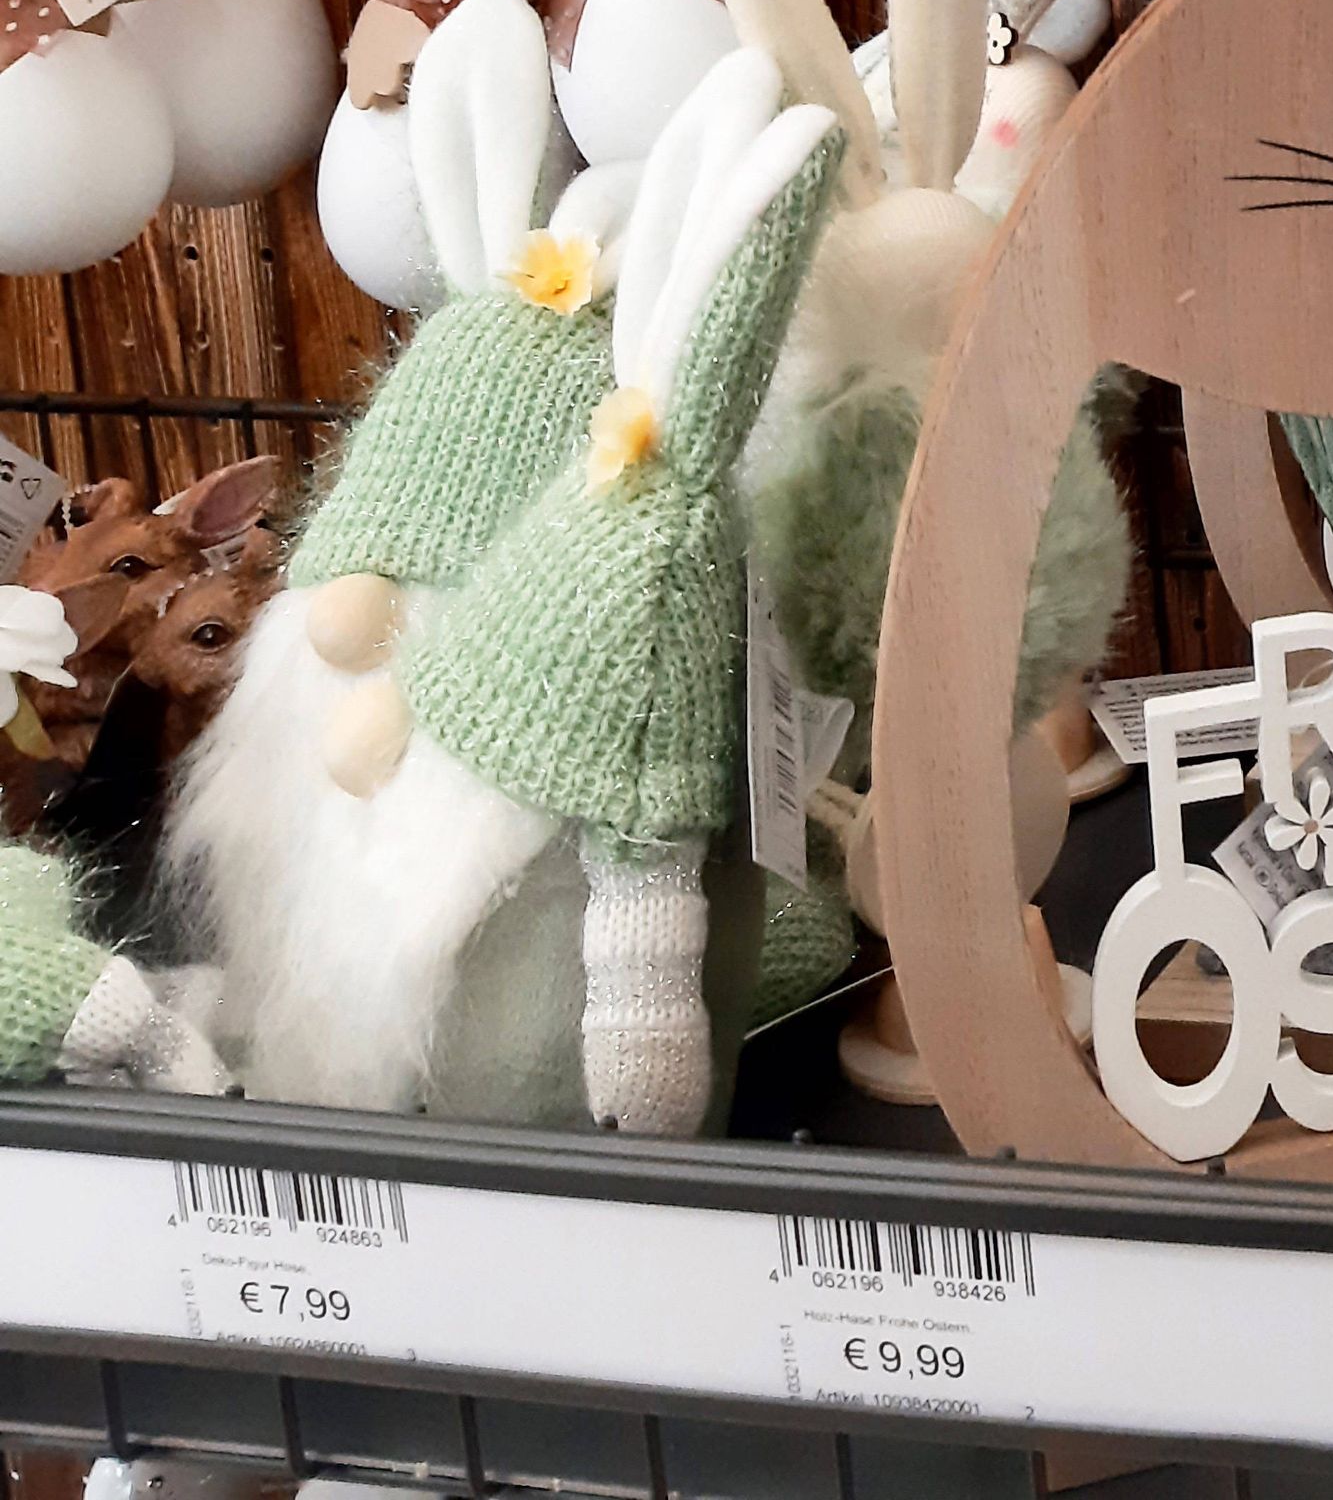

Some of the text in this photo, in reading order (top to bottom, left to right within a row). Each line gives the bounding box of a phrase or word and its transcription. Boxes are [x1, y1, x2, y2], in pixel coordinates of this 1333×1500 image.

[168, 1214, 383, 1248] 4 062196 924863
[240, 1281, 351, 1323] € 7,99
[769, 1269, 1006, 1302] 4 062196 938426
[844, 1338, 965, 1380] € 9,99
